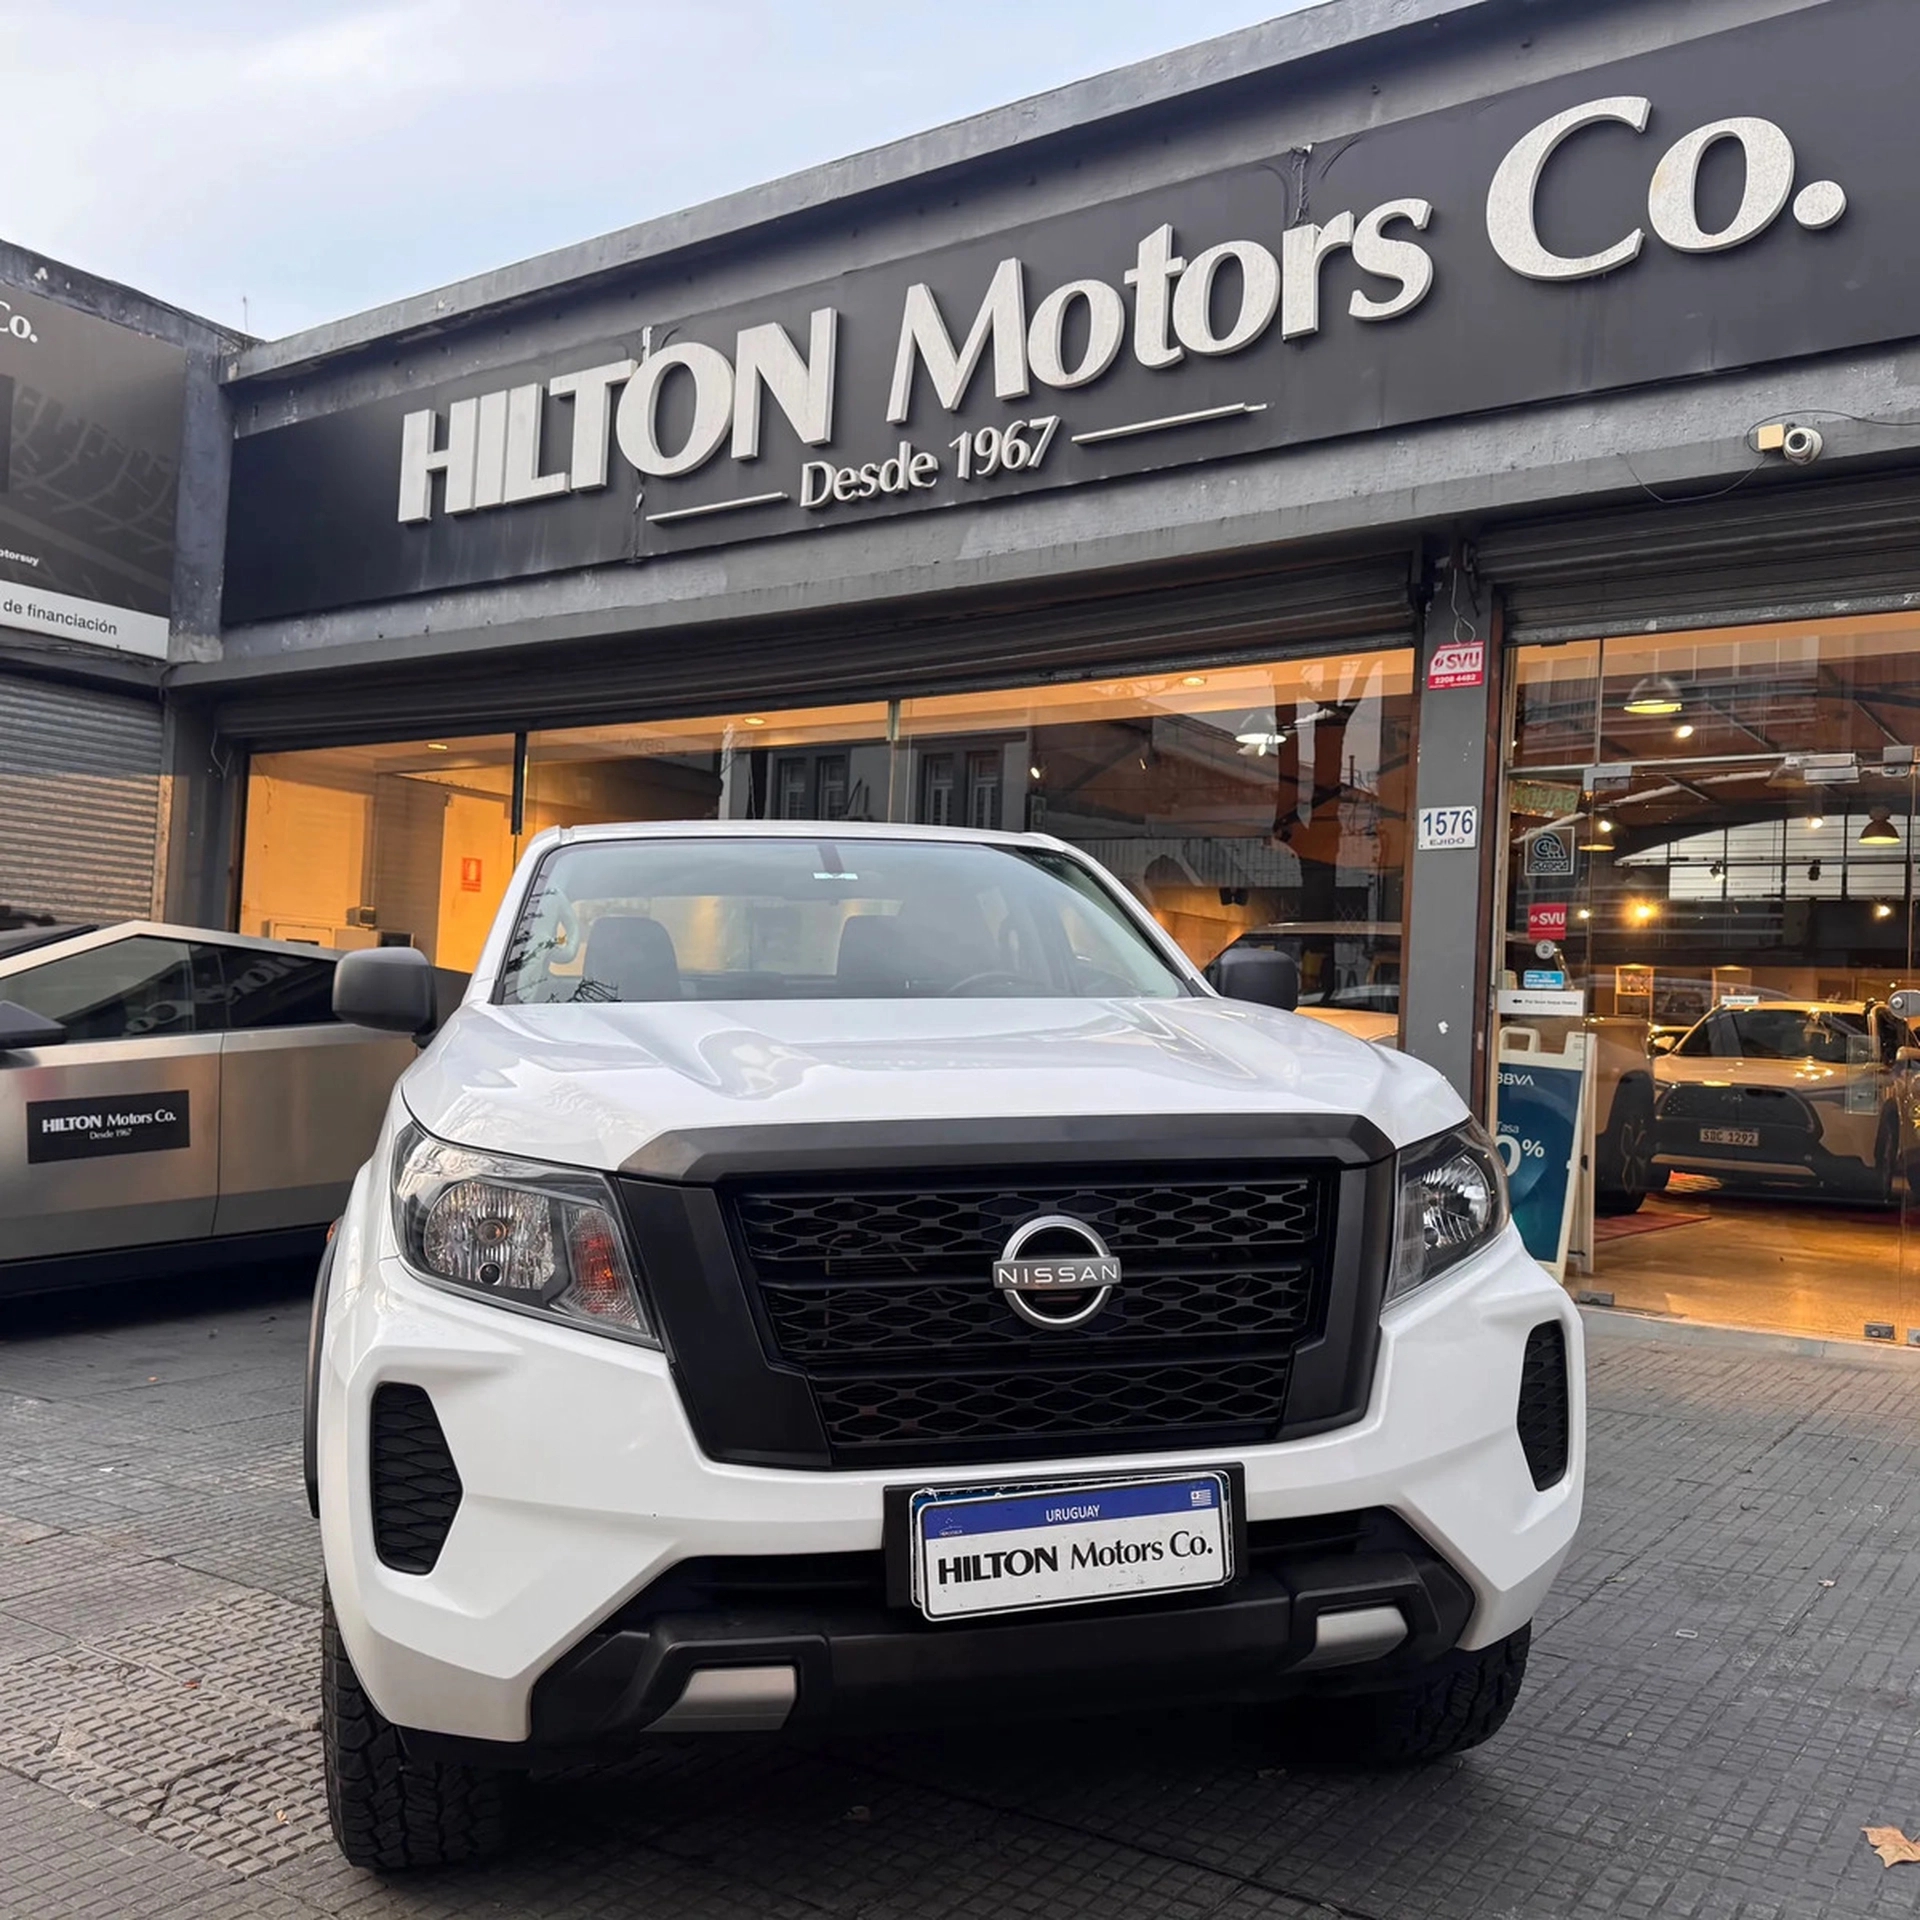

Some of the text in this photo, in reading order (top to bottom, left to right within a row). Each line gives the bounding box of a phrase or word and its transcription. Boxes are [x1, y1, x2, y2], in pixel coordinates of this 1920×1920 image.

[398, 95, 1847, 524] HILTON Motors Co.
[800, 415, 1061, 510] Desde 1967
[2, 599, 118, 636] de financiación
[1446, 652, 1479, 670] SVU
[1423, 810, 1474, 837] 1576
[1429, 837, 1465, 846] EJIDO
[1538, 912, 1566, 925] SVU
[42, 1109, 177, 1133] HILTON Motors Co.
[89, 1129, 114, 1140] Desde
[1728, 1132, 1755, 1144] 1292
[998, 1264, 1118, 1284] NISSAN
[1045, 1504, 1100, 1522] URUGUAY
[938, 1530, 1214, 1585] HILTON Motors Co.
